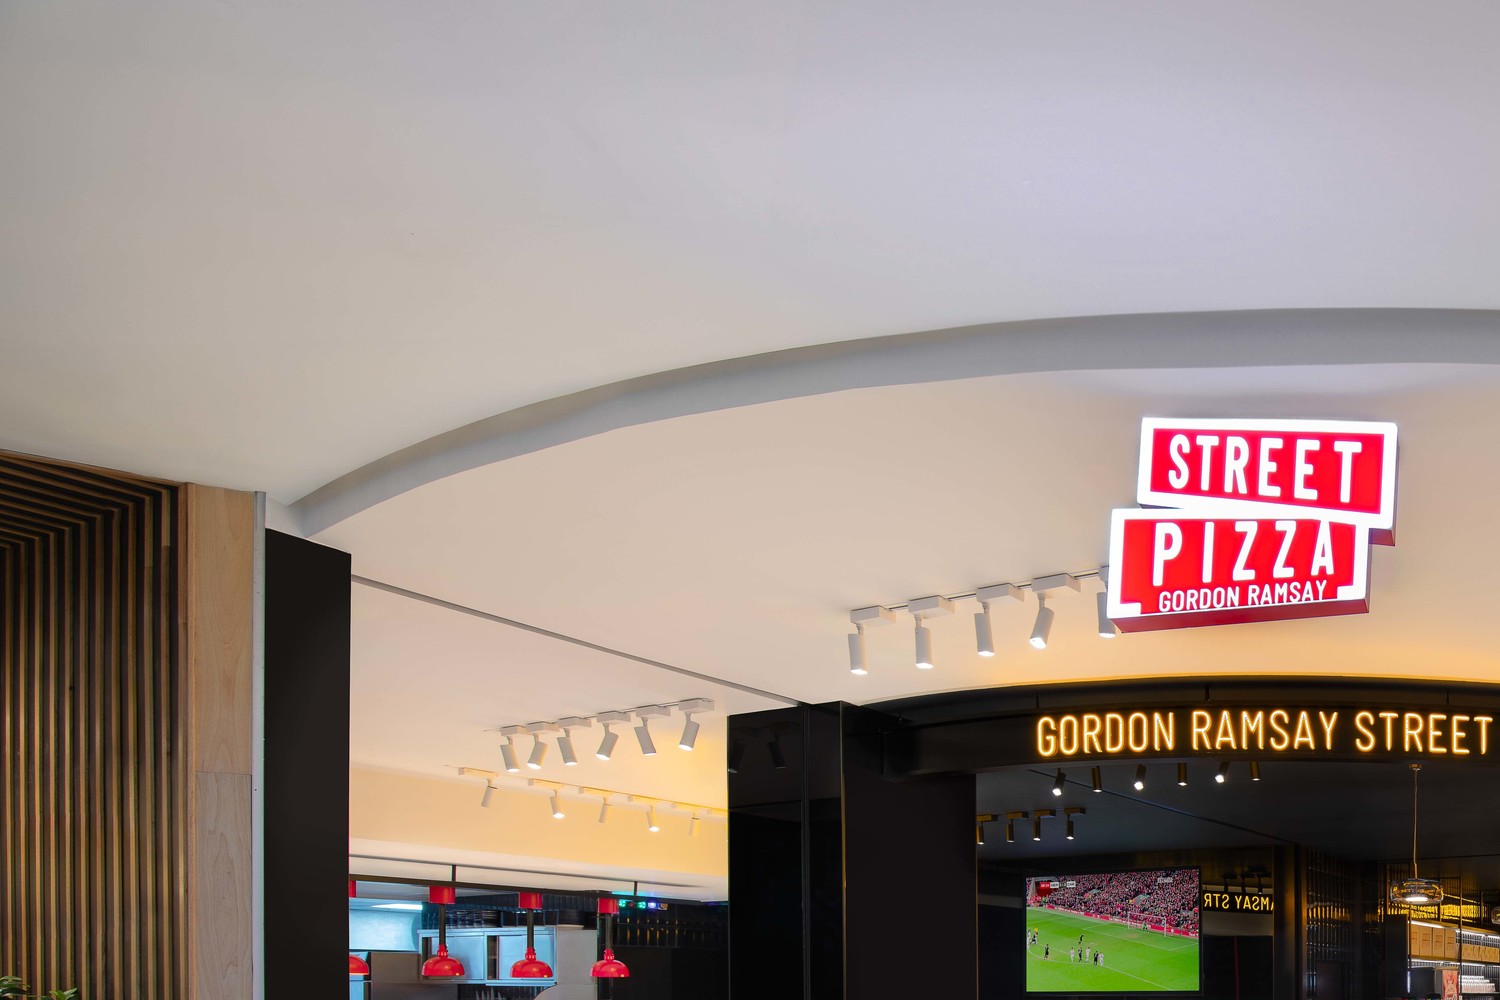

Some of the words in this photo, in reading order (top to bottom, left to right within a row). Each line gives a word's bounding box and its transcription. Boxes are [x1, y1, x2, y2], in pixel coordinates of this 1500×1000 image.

[1168, 433, 1363, 504] STREET
[1152, 519, 1335, 587] PIZZA
[1158, 584, 1241, 613] GORDON
[1246, 579, 1329, 607] RAMSAY
[1036, 711, 1175, 757] GORDON
[1191, 709, 1339, 751] RAMSAY
[1354, 710, 1494, 755] STREET
